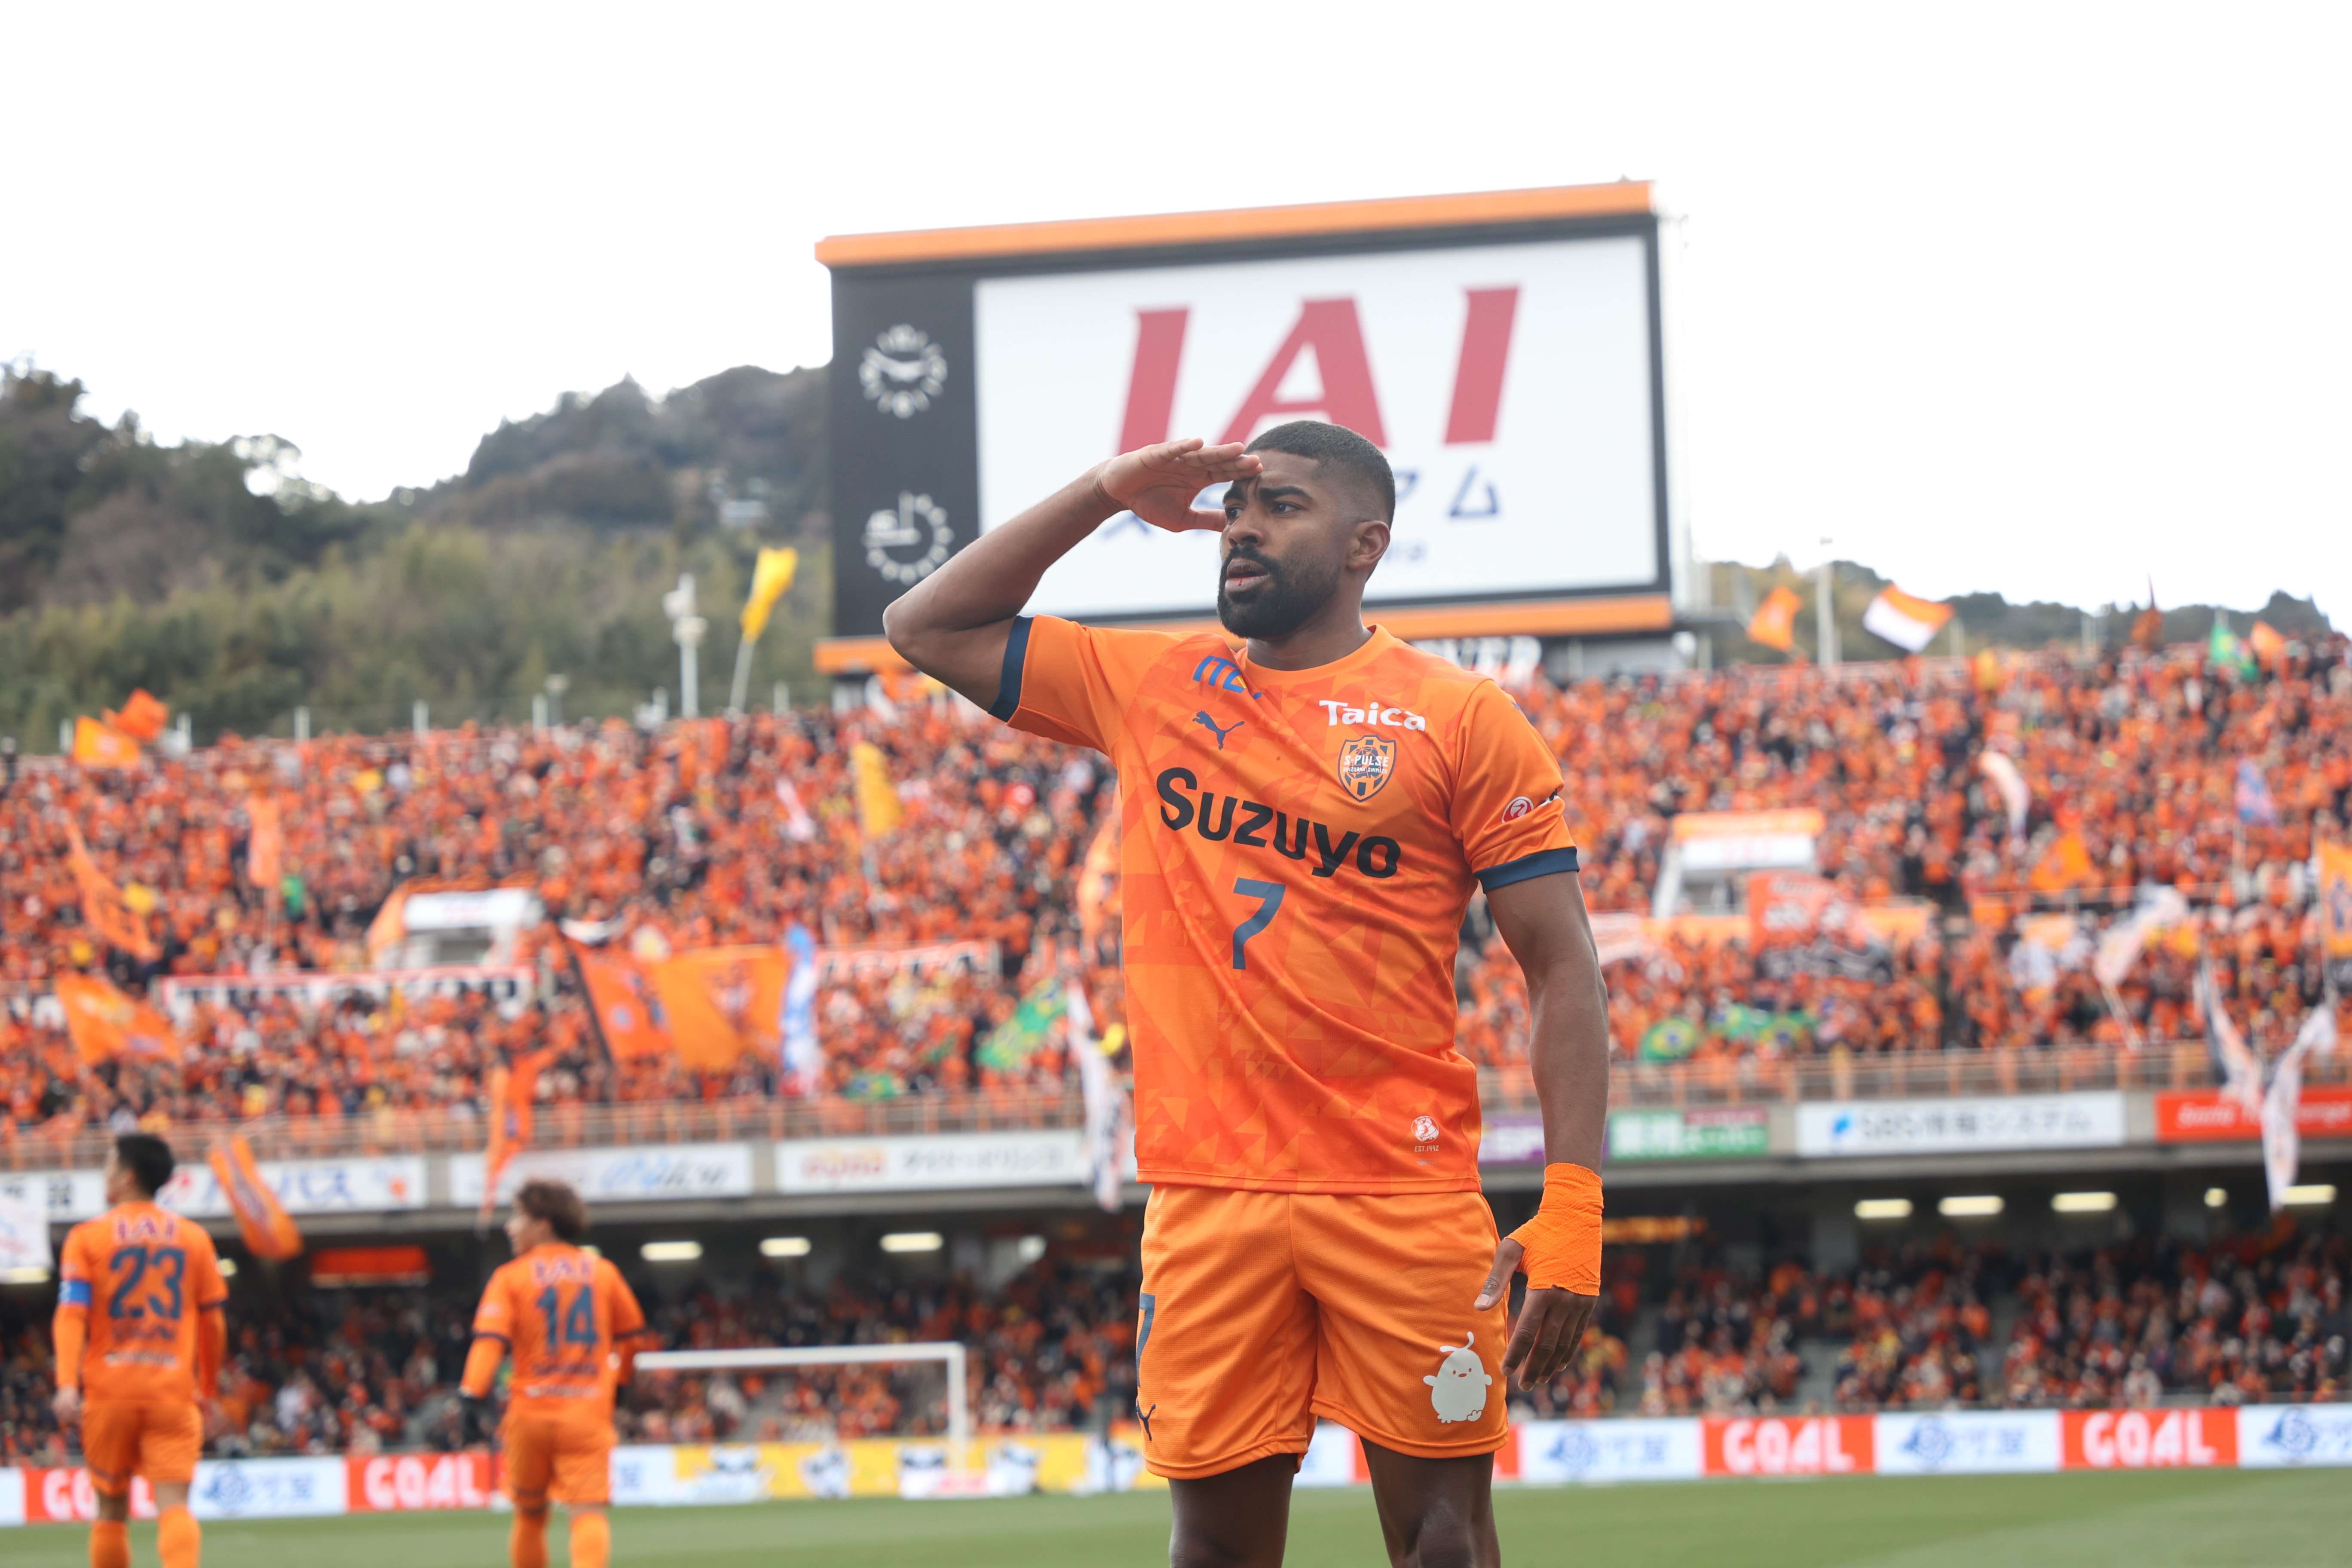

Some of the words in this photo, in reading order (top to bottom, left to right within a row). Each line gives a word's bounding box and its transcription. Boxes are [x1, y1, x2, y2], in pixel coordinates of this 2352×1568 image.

[1113, 284, 1522, 461] IAI
[1319, 700, 1426, 732] Taica
[1344, 755, 1390, 767] S-PULSE
[1156, 767, 1401, 878] Suzuyo
[1232, 877, 1286, 970] 7
[110, 1247, 185, 1319] 23
[536, 1285, 599, 1351] 14
[1722, 1420, 1855, 1474] GOAL
[2083, 1410, 2217, 1467] GOAL
[42, 1467, 160, 1521] GOL
[365, 1455, 483, 1510] GOAL
